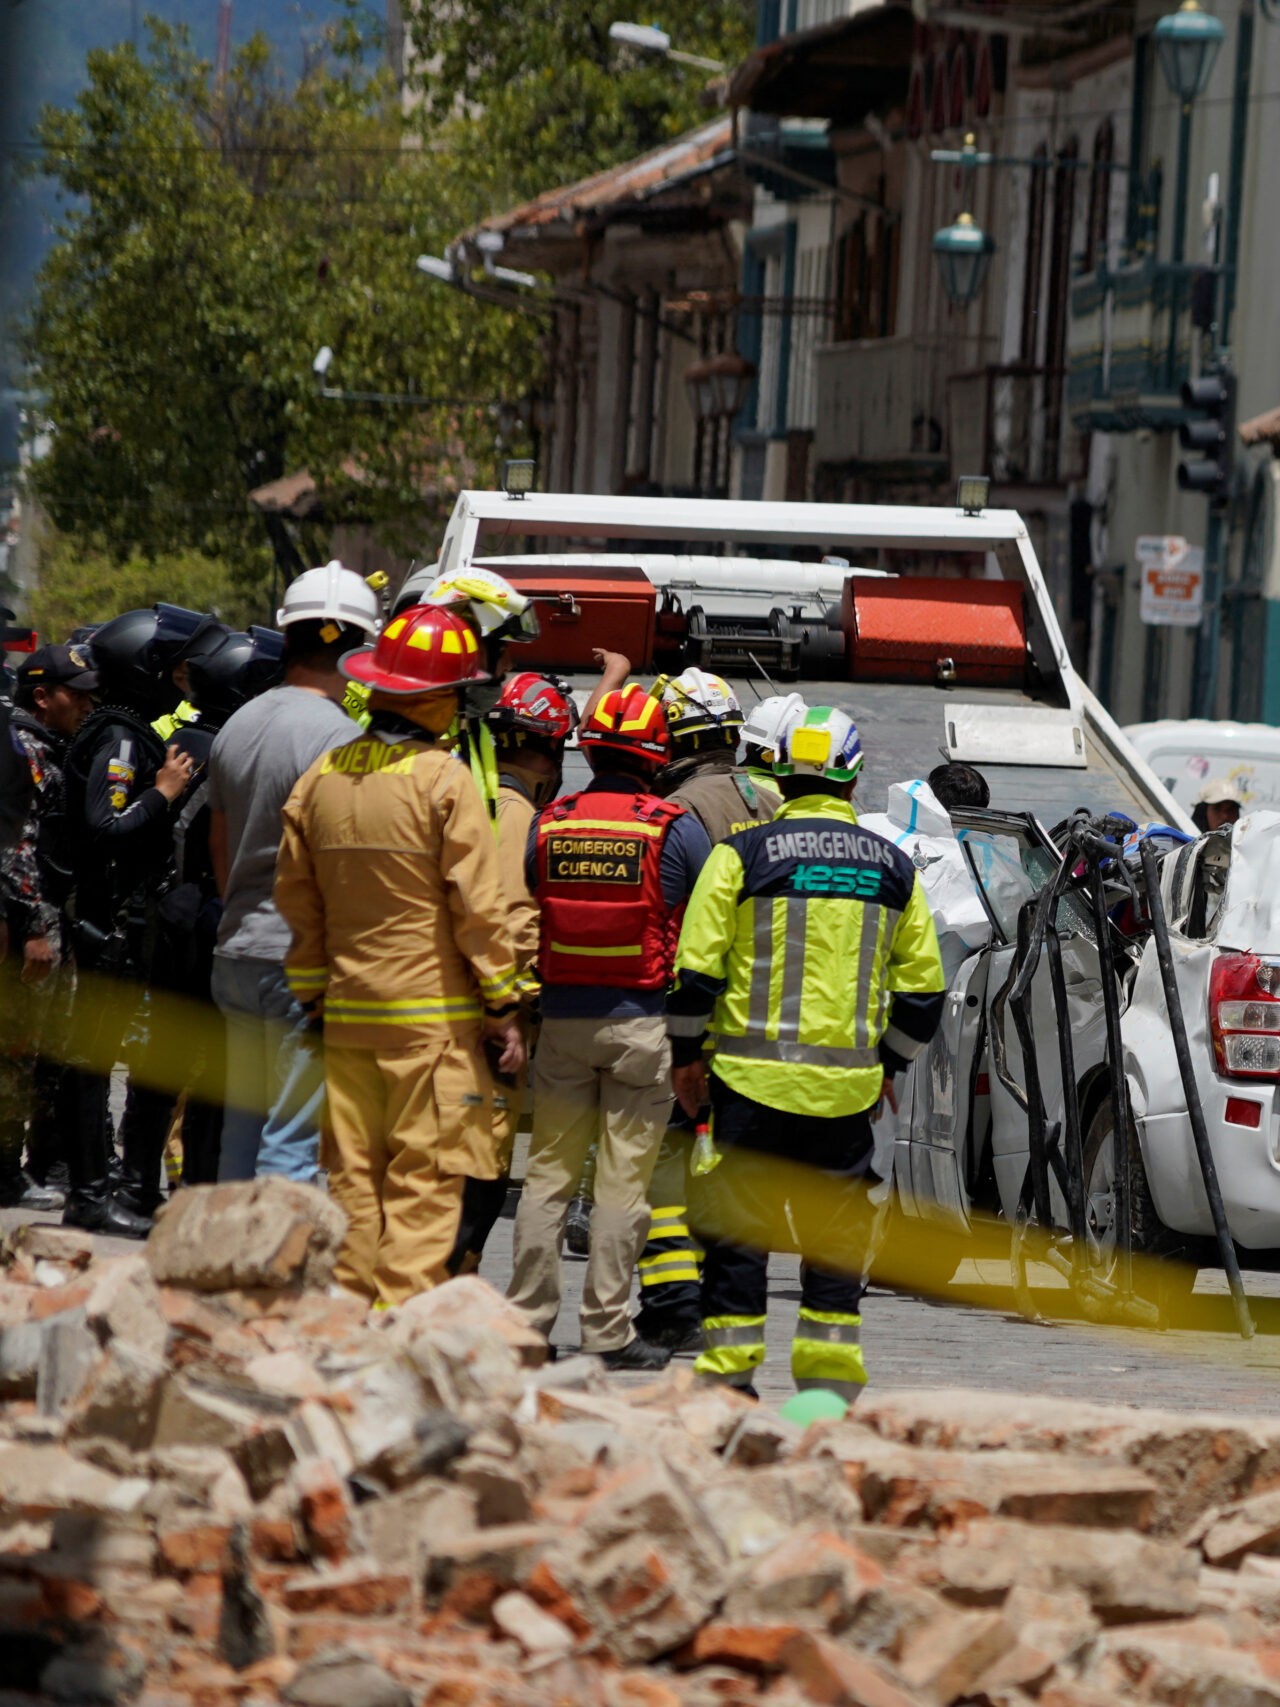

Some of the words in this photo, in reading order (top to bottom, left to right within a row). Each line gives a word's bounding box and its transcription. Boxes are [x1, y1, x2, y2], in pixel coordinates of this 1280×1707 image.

[319, 741, 417, 775] CUENCA
[552, 839, 637, 858] BOMBEROS
[765, 831, 894, 868] EMERGENCIAS
[557, 860, 629, 879] CUENCA
